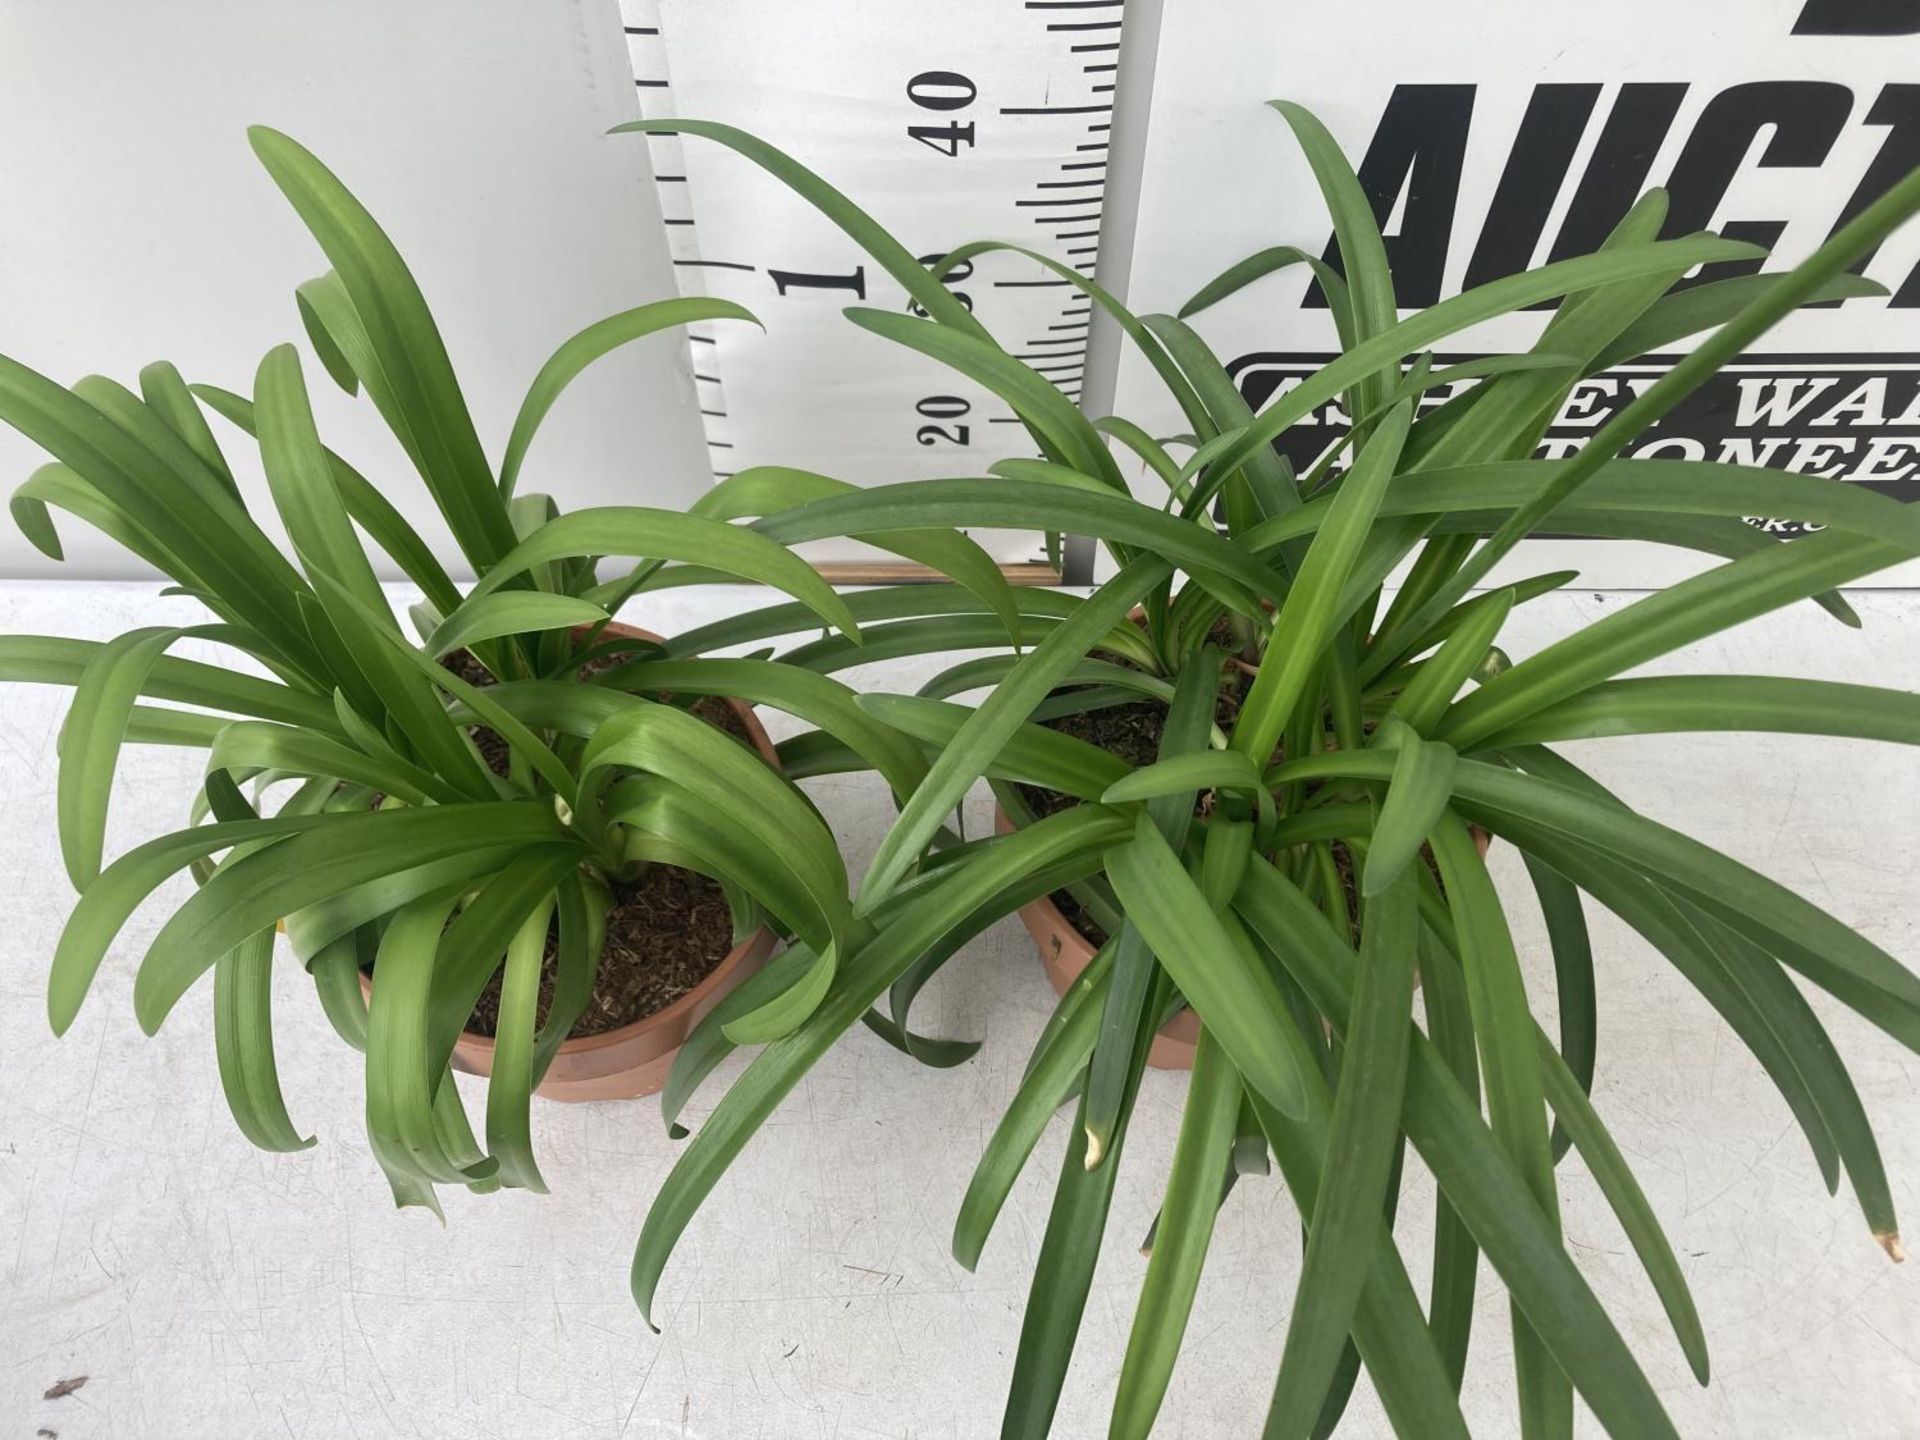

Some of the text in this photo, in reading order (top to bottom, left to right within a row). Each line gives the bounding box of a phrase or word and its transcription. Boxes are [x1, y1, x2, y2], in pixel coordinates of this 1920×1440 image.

[906, 71, 977, 157] 40
[1300, 80, 1920, 311] AUCT
[767, 265, 866, 300] 1
[915, 395, 971, 446] 20
[1735, 377, 1920, 427] WA
